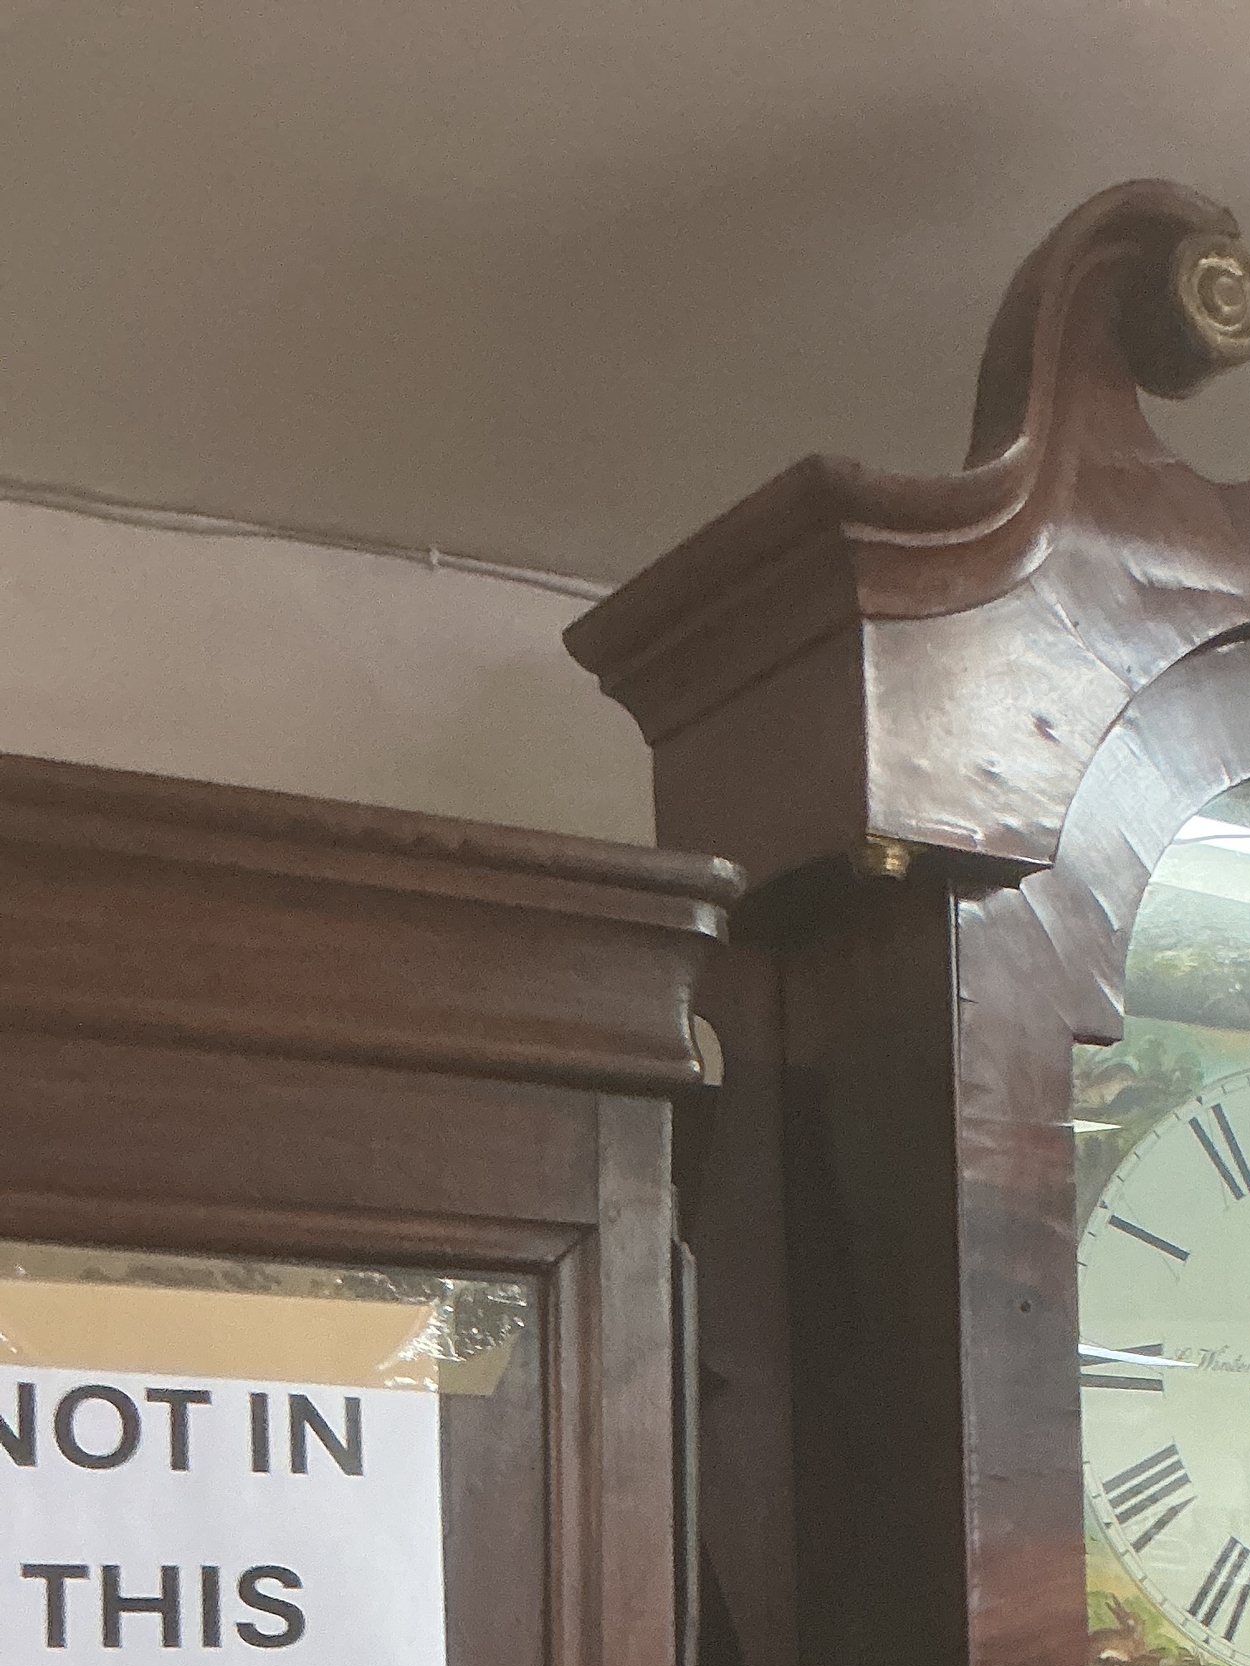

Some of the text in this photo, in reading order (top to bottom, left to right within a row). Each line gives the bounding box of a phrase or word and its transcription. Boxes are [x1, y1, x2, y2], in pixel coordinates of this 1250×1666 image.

[248, 1391, 365, 1477] IN
[1102, 1442, 1198, 1553] VIII
[21, 1562, 307, 1649] THIS
